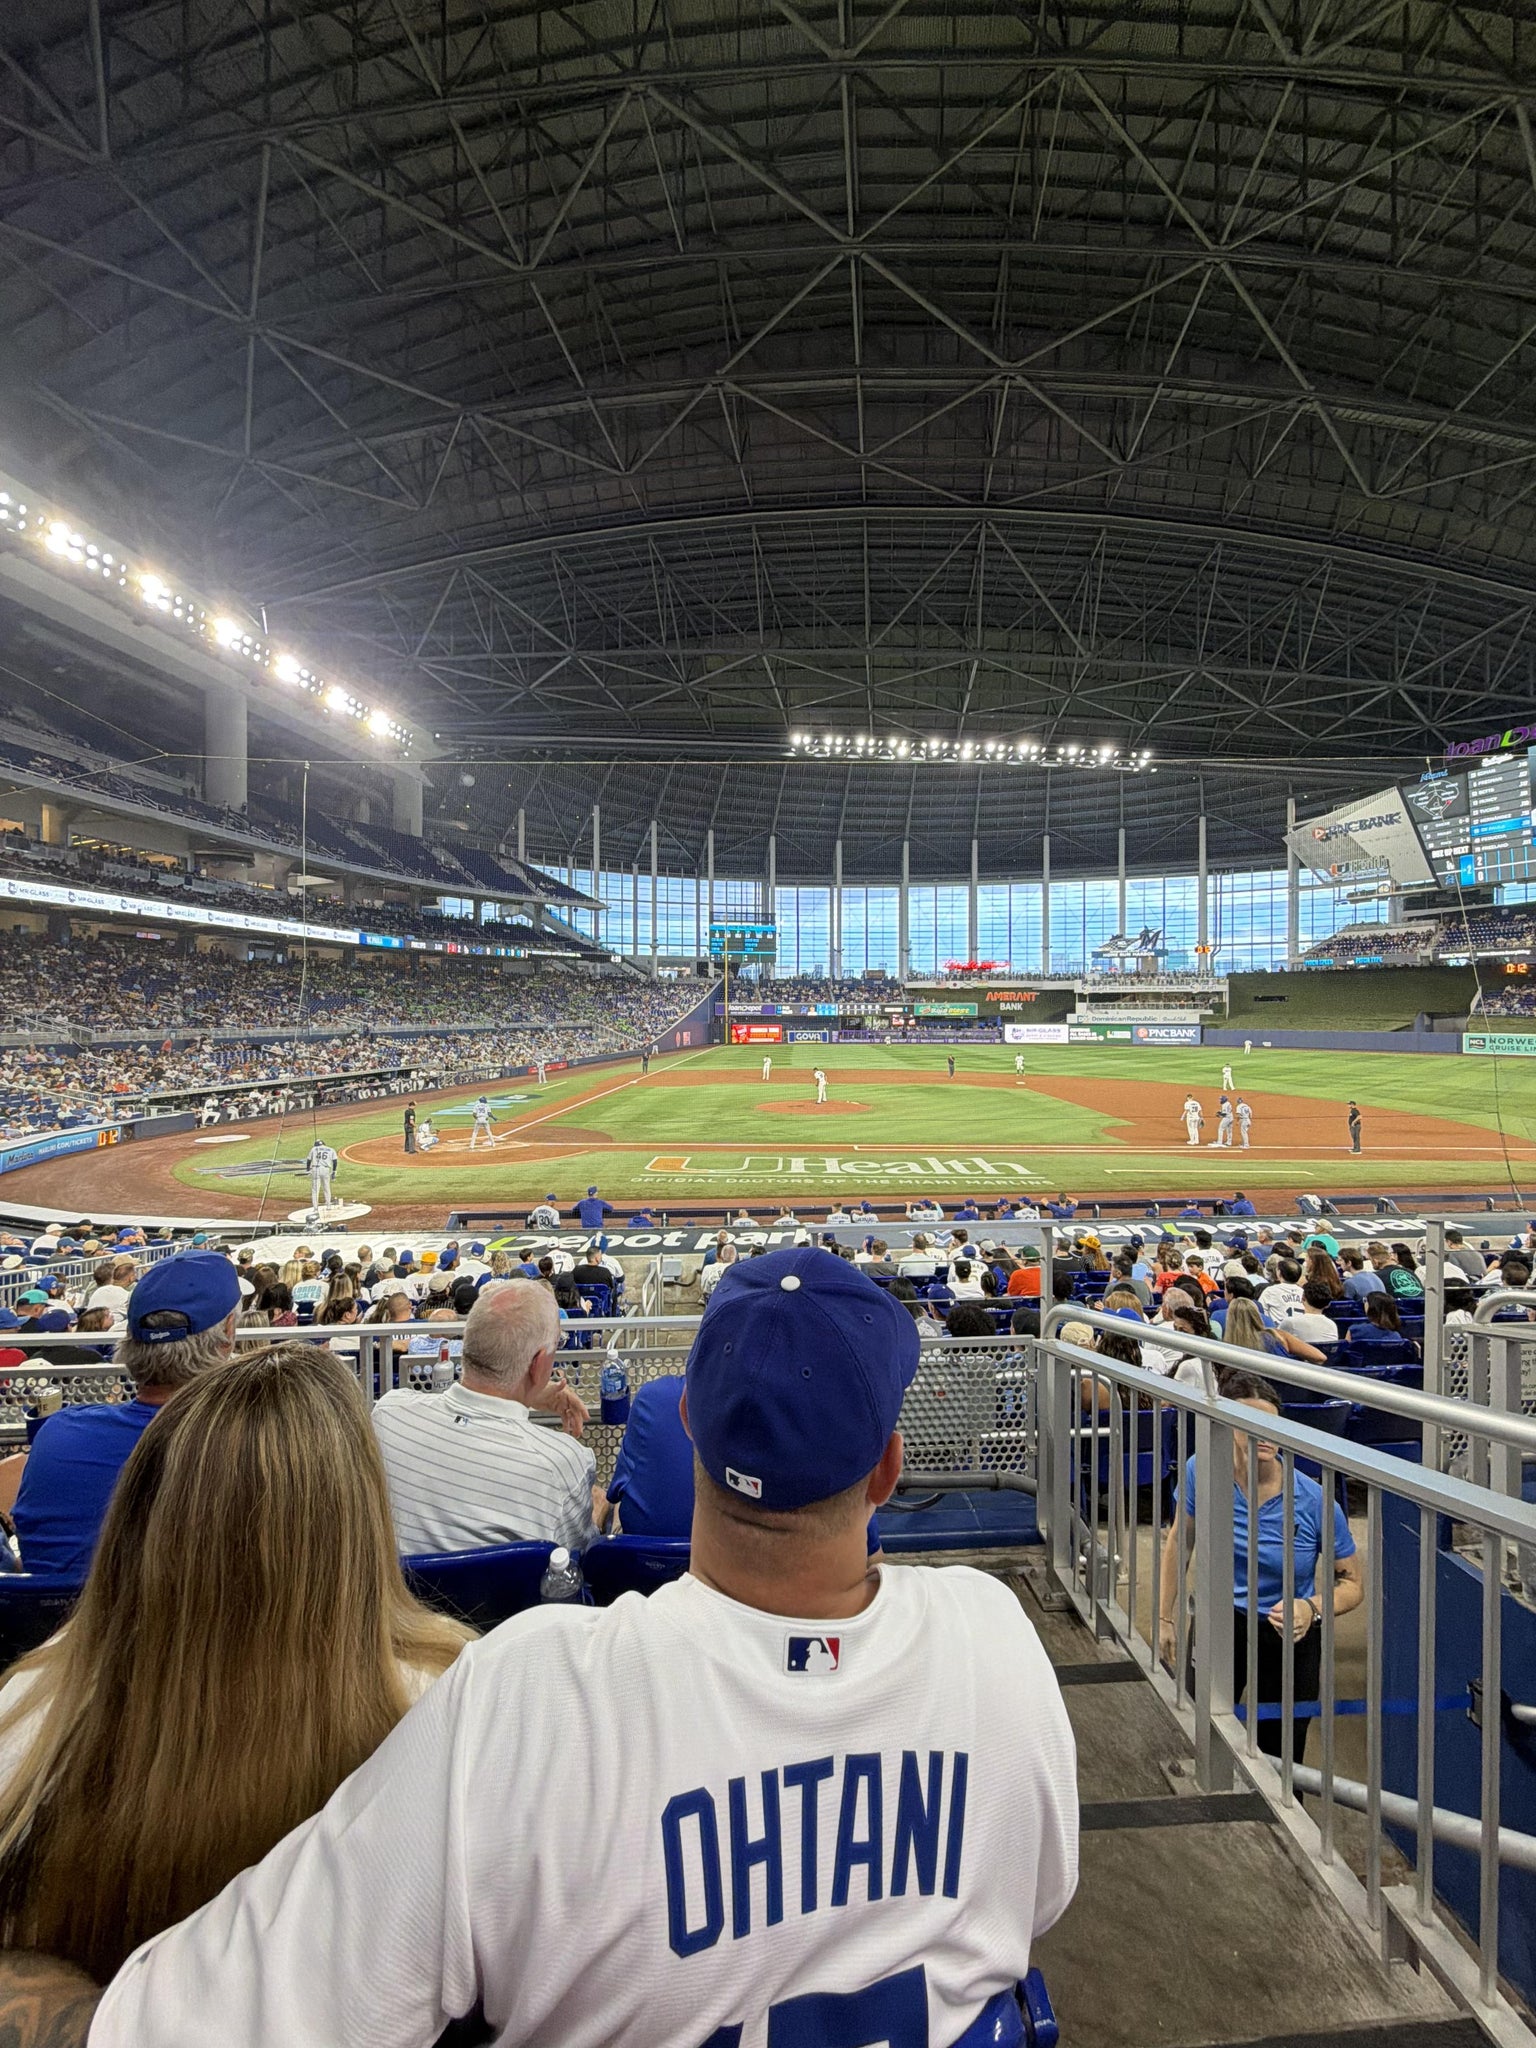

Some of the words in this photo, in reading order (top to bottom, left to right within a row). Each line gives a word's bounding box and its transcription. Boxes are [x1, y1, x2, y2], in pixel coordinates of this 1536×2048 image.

[985, 991, 1037, 1001] AMERANT
[1000, 1003, 1023, 1011] BANK
[315, 1151, 328, 1161] 46
[538, 1215, 551, 1226] 30
[555, 1261, 564, 1274] 7
[661, 1749, 969, 1958] OHTANI
